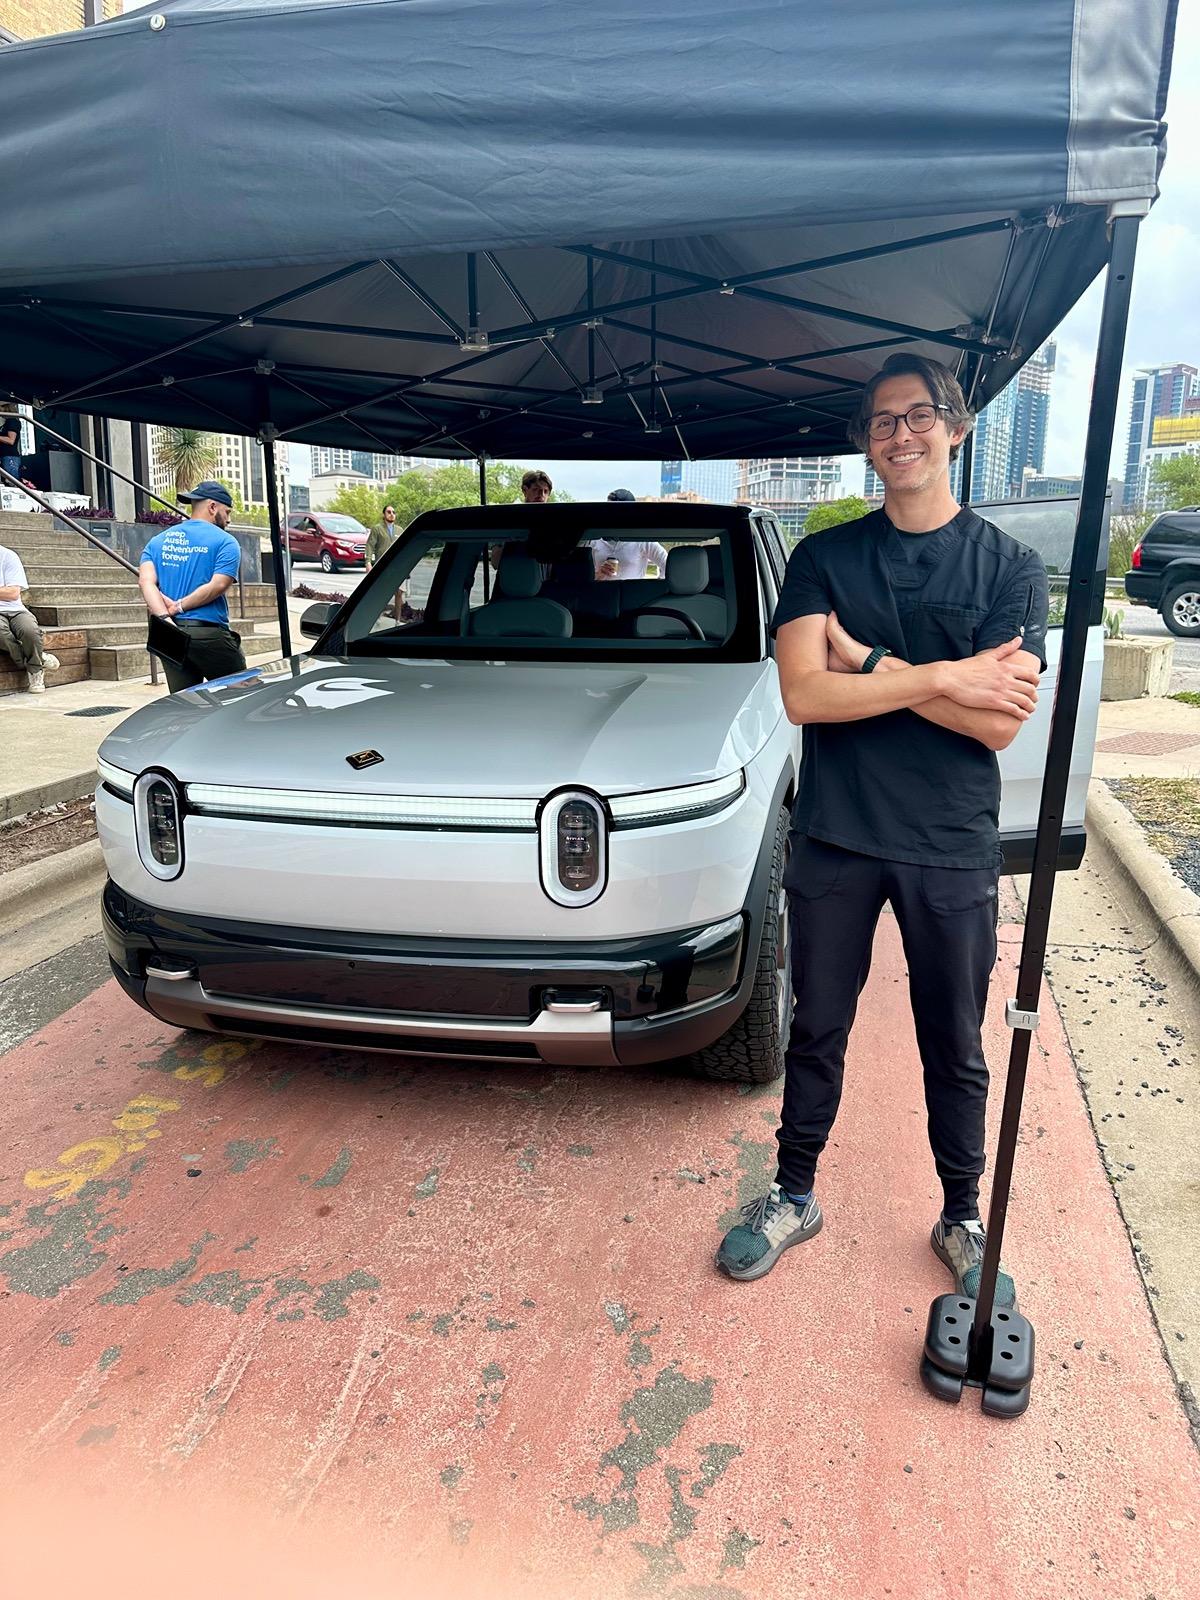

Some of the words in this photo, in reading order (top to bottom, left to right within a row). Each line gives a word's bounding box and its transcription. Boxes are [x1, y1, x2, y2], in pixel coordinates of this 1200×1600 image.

[163, 537, 190, 546] Austin
[162, 544, 208, 553] adventurous
[162, 552, 189, 562] forever
